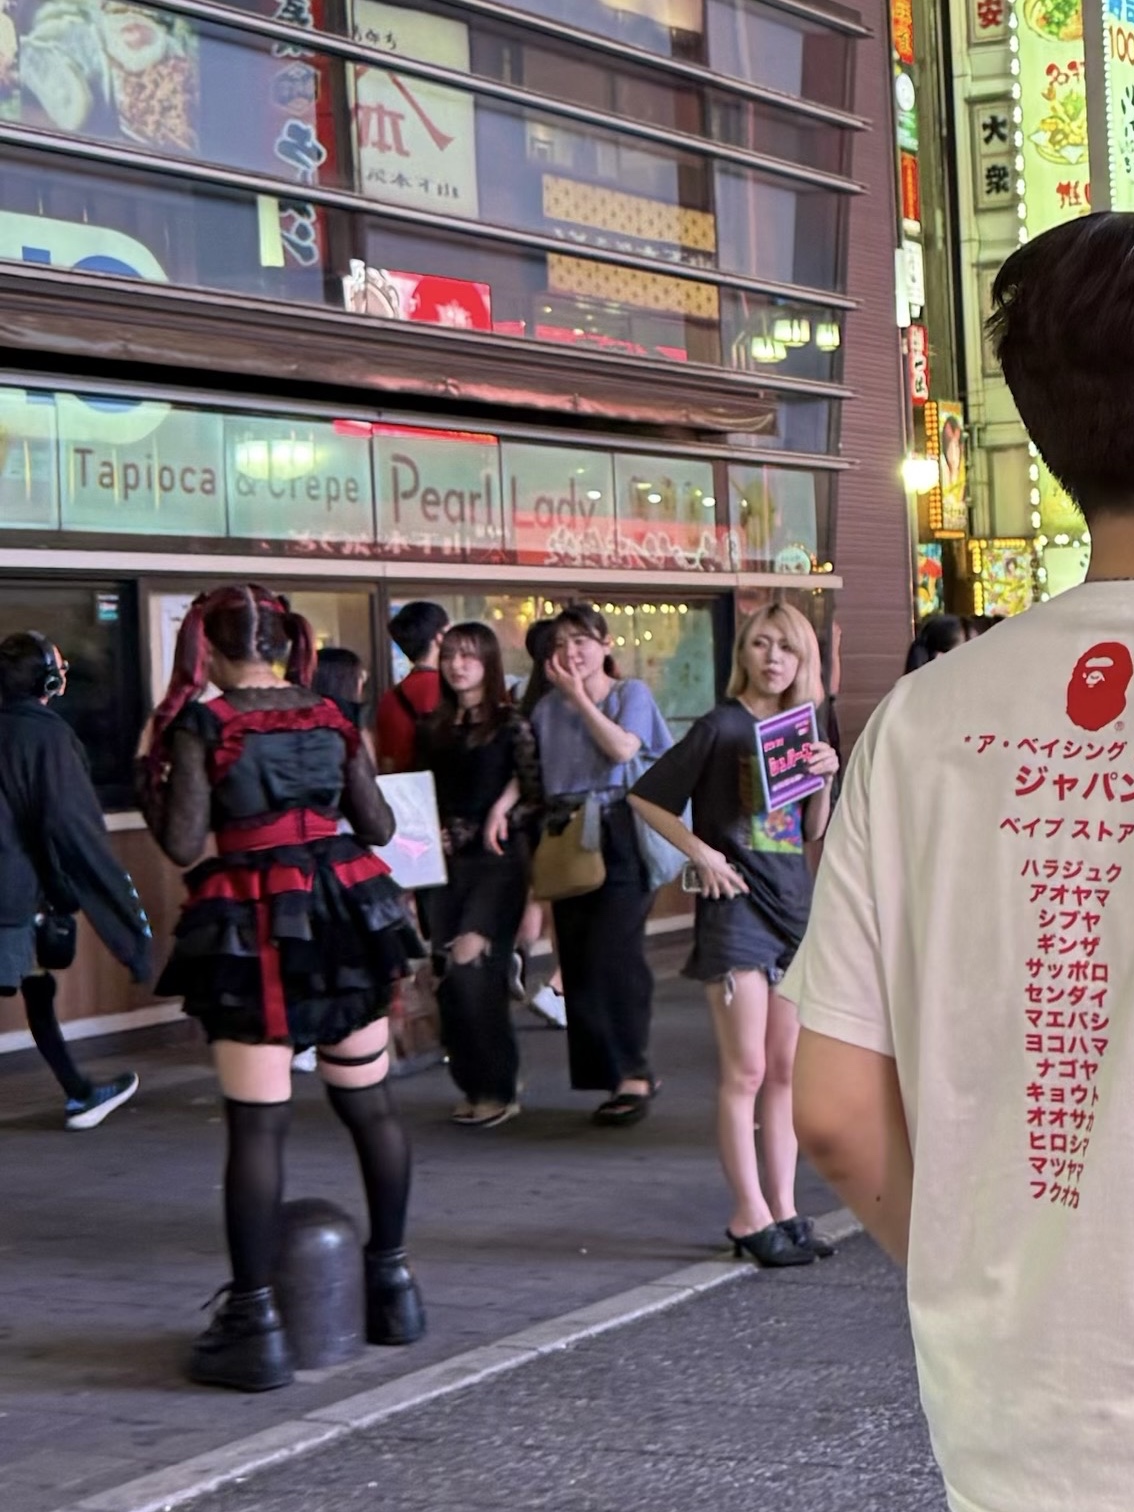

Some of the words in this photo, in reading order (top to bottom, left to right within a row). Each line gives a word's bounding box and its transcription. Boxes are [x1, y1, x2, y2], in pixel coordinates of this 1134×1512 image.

[982, 115, 1010, 195] 大衆
[73, 447, 218, 500] Tapioca
[390, 454, 494, 526] Pearl
[511, 475, 598, 536] Lady
[1021, 859, 1122, 883] ハラジュク
[1030, 884, 1110, 907] アオヤマ
[1039, 909, 1101, 933] シブヤ
[1038, 934, 1100, 957] ギンザ
[1025, 958, 1108, 982] サッポロ
[1025, 983, 1108, 1008] センダイ
[1025, 1009, 1109, 1031] マエバシ
[1025, 1034, 1109, 1056] ヨコハマ
[1036, 1058, 1099, 1081] ナゴヤ
[1026, 1082, 1099, 1107] キョウト
[1027, 1106, 1095, 1132] オオサカ
[1029, 1131, 1089, 1157] ヒロシマ
[1028, 1156, 1084, 1182] マツヤマ
[1030, 1180, 1080, 1209] フクオカ
